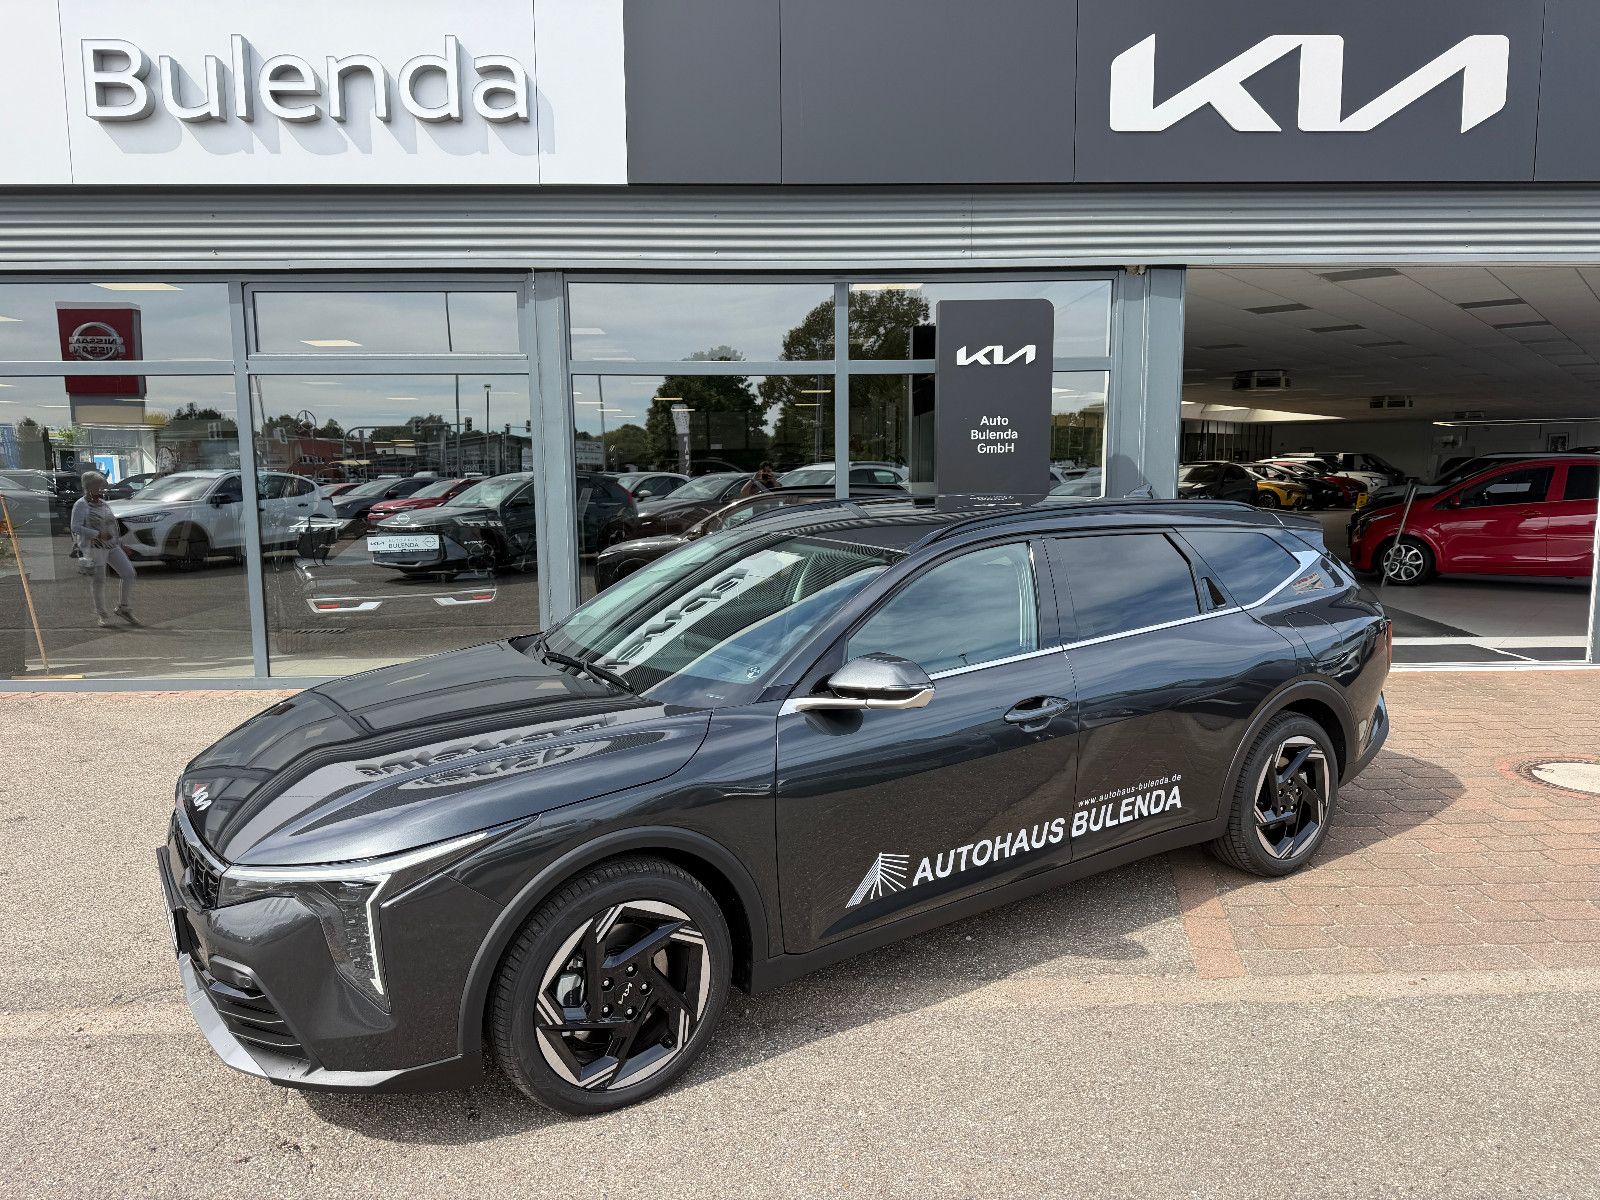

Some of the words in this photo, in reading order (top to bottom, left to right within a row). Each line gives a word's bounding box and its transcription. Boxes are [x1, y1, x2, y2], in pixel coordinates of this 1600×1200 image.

[81, 34, 531, 121] Bulenda
[1109, 33, 1510, 133] KIA
[956, 344, 1037, 366] KIA
[970, 428, 1019, 440] Bulenda
[980, 415, 1009, 426] Auto
[977, 443, 1015, 454] GmbH
[1078, 773, 1182, 807] www.autohaus-bulenda.de
[912, 817, 1066, 886] AUTOHAUS
[1071, 785, 1182, 838] BULENDA
